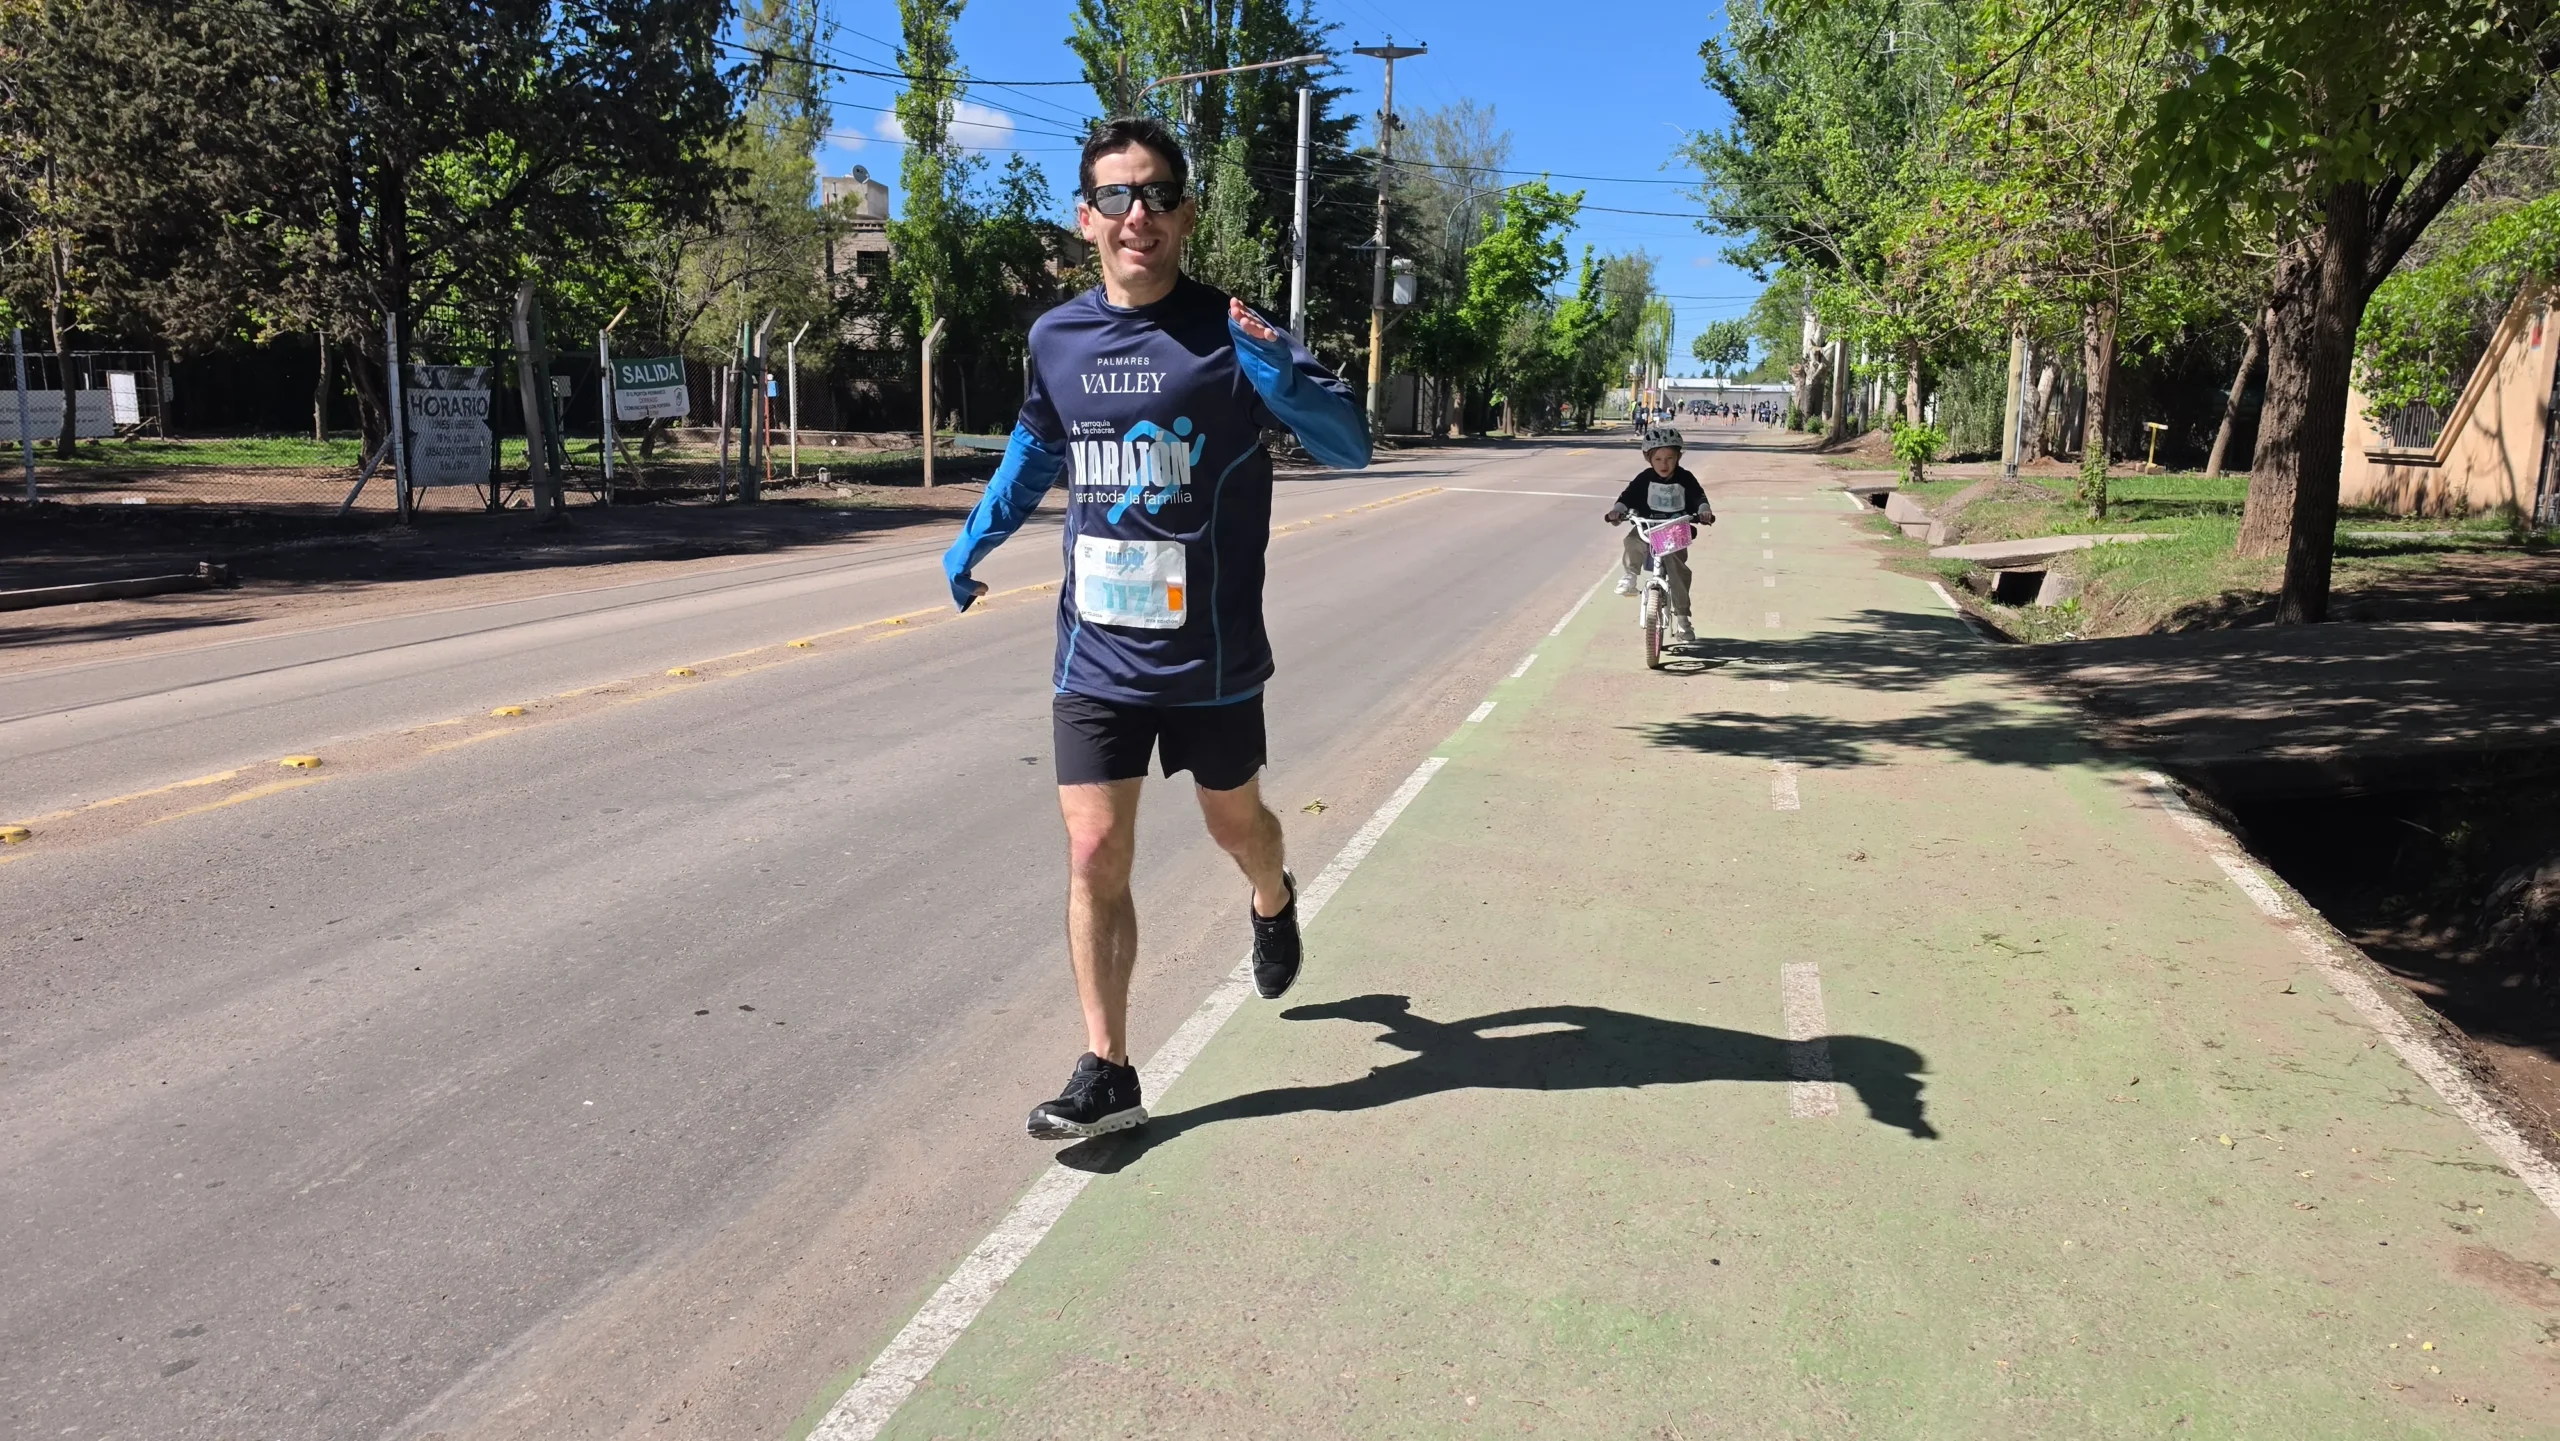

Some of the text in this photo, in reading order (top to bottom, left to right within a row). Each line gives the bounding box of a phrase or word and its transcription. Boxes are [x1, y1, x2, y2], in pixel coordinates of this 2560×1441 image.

[1097, 357, 1150, 366] PALMARES
[622, 362, 679, 384] SALIDA
[1081, 372, 1166, 394] VALLEY
[410, 395, 488, 417] HORARIO
[1080, 419, 1111, 428] parroquia
[1096, 490, 1125, 503] toda
[1129, 490, 1140, 504] la
[1143, 490, 1193, 505] familia
[1102, 582, 1150, 611] 117
